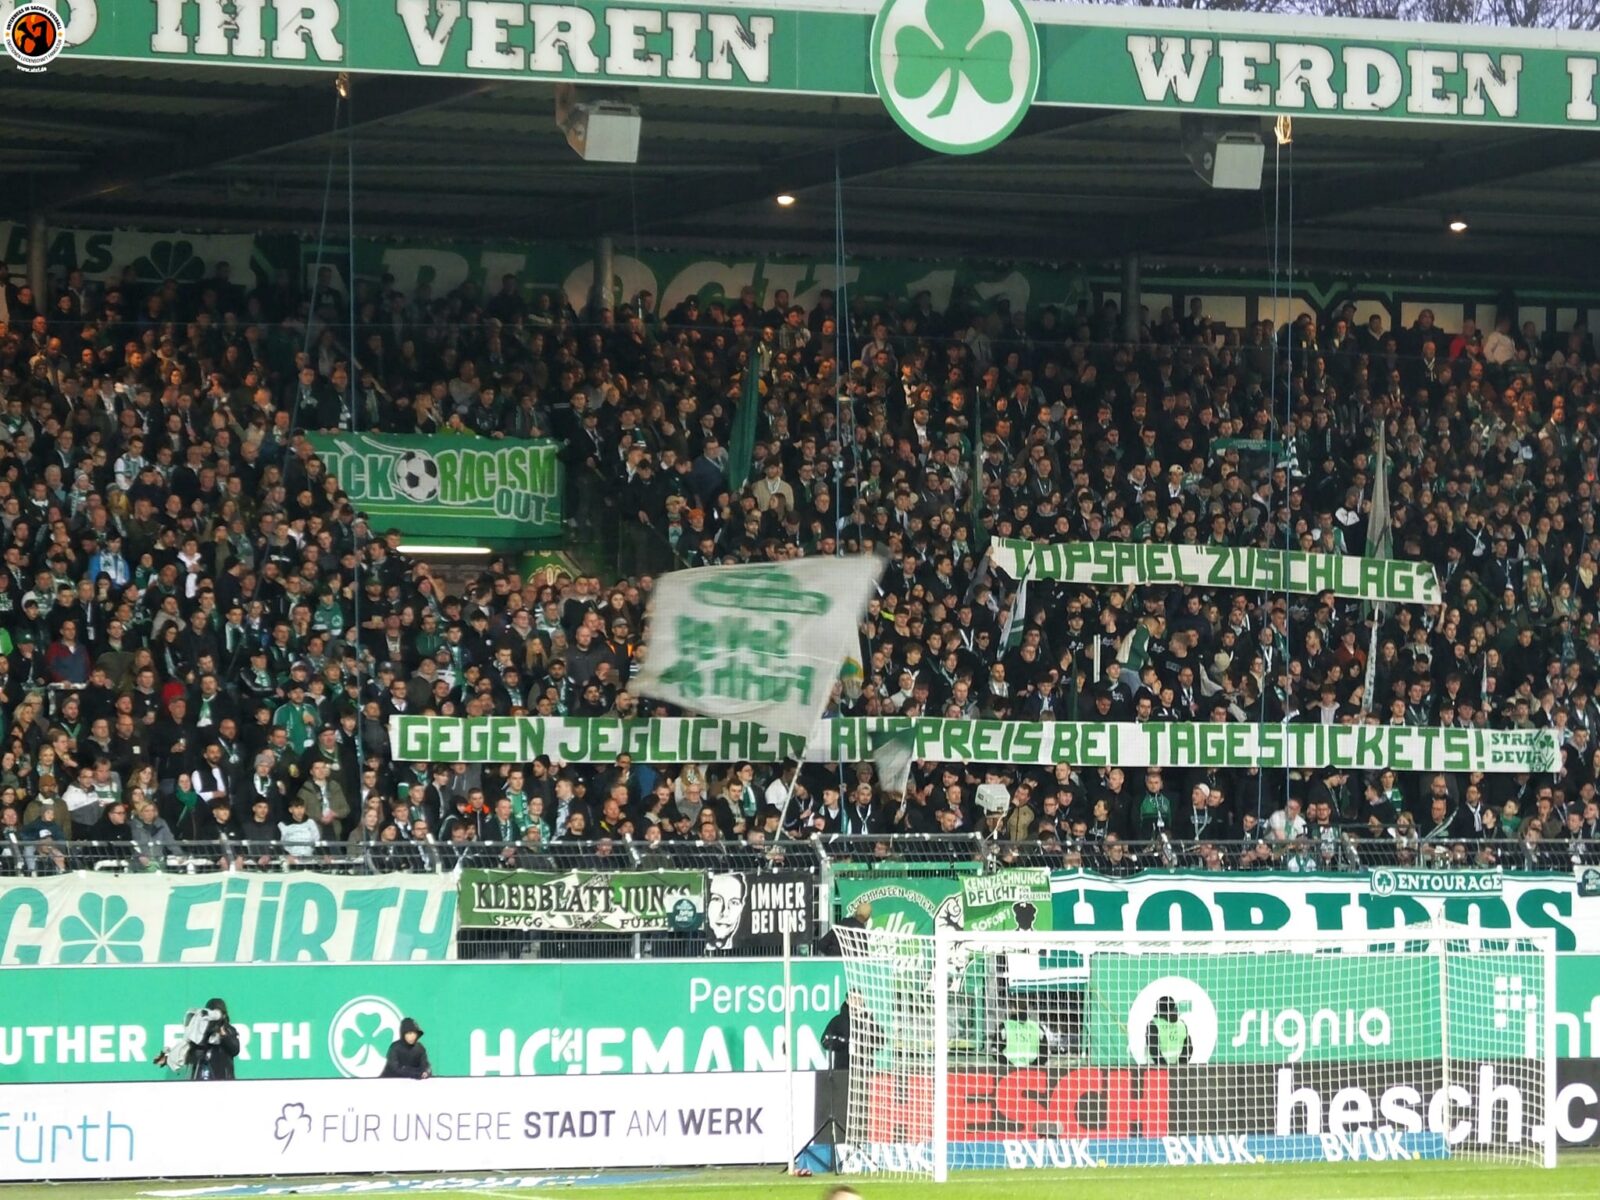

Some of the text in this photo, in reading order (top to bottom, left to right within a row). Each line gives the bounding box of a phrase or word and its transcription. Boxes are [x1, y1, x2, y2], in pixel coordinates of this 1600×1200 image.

[152, 0, 345, 62] IHR
[398, 0, 775, 83] VEREIN
[1126, 35, 1523, 119] WERDEN
[314, 445, 559, 505] ICK RACISM
[399, 716, 545, 761] GEGEN
[1051, 722, 1119, 766] BEI
[1143, 721, 1486, 771] TAGESTICKETS!
[750, 881, 806, 910] IMMER
[968, 885, 1017, 906] PFLICHT
[1397, 871, 1503, 893] ENTOURAGE
[751, 910, 775, 935] BEI
[689, 974, 840, 1015] Personal
[1231, 1007, 1392, 1063] signia
[322, 1107, 381, 1144] FÜR
[392, 1111, 512, 1143] UNSERE
[523, 1109, 616, 1140] STADT
[626, 1109, 668, 1138] AM
[677, 1106, 764, 1137] WERK
